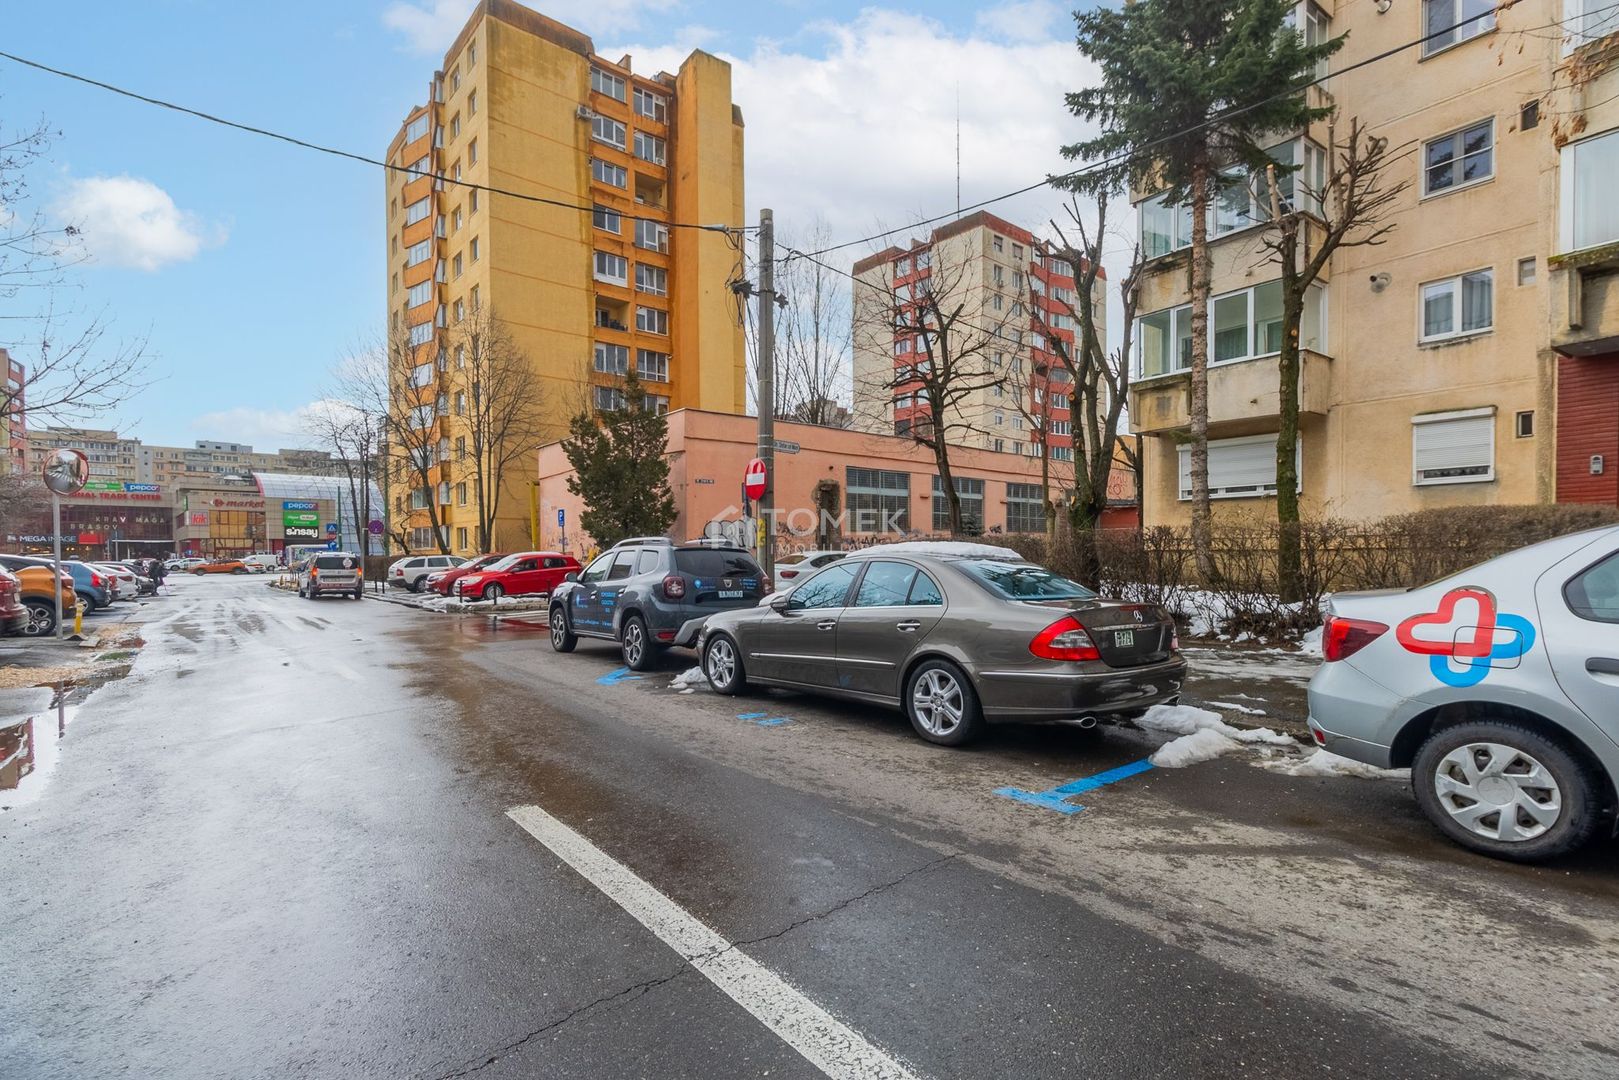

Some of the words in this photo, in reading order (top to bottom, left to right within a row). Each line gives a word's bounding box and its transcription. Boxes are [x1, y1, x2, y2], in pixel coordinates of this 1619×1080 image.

[130, 484, 158, 492] pepco
[226, 500, 264, 508] market
[286, 526, 318, 538] sinsay
